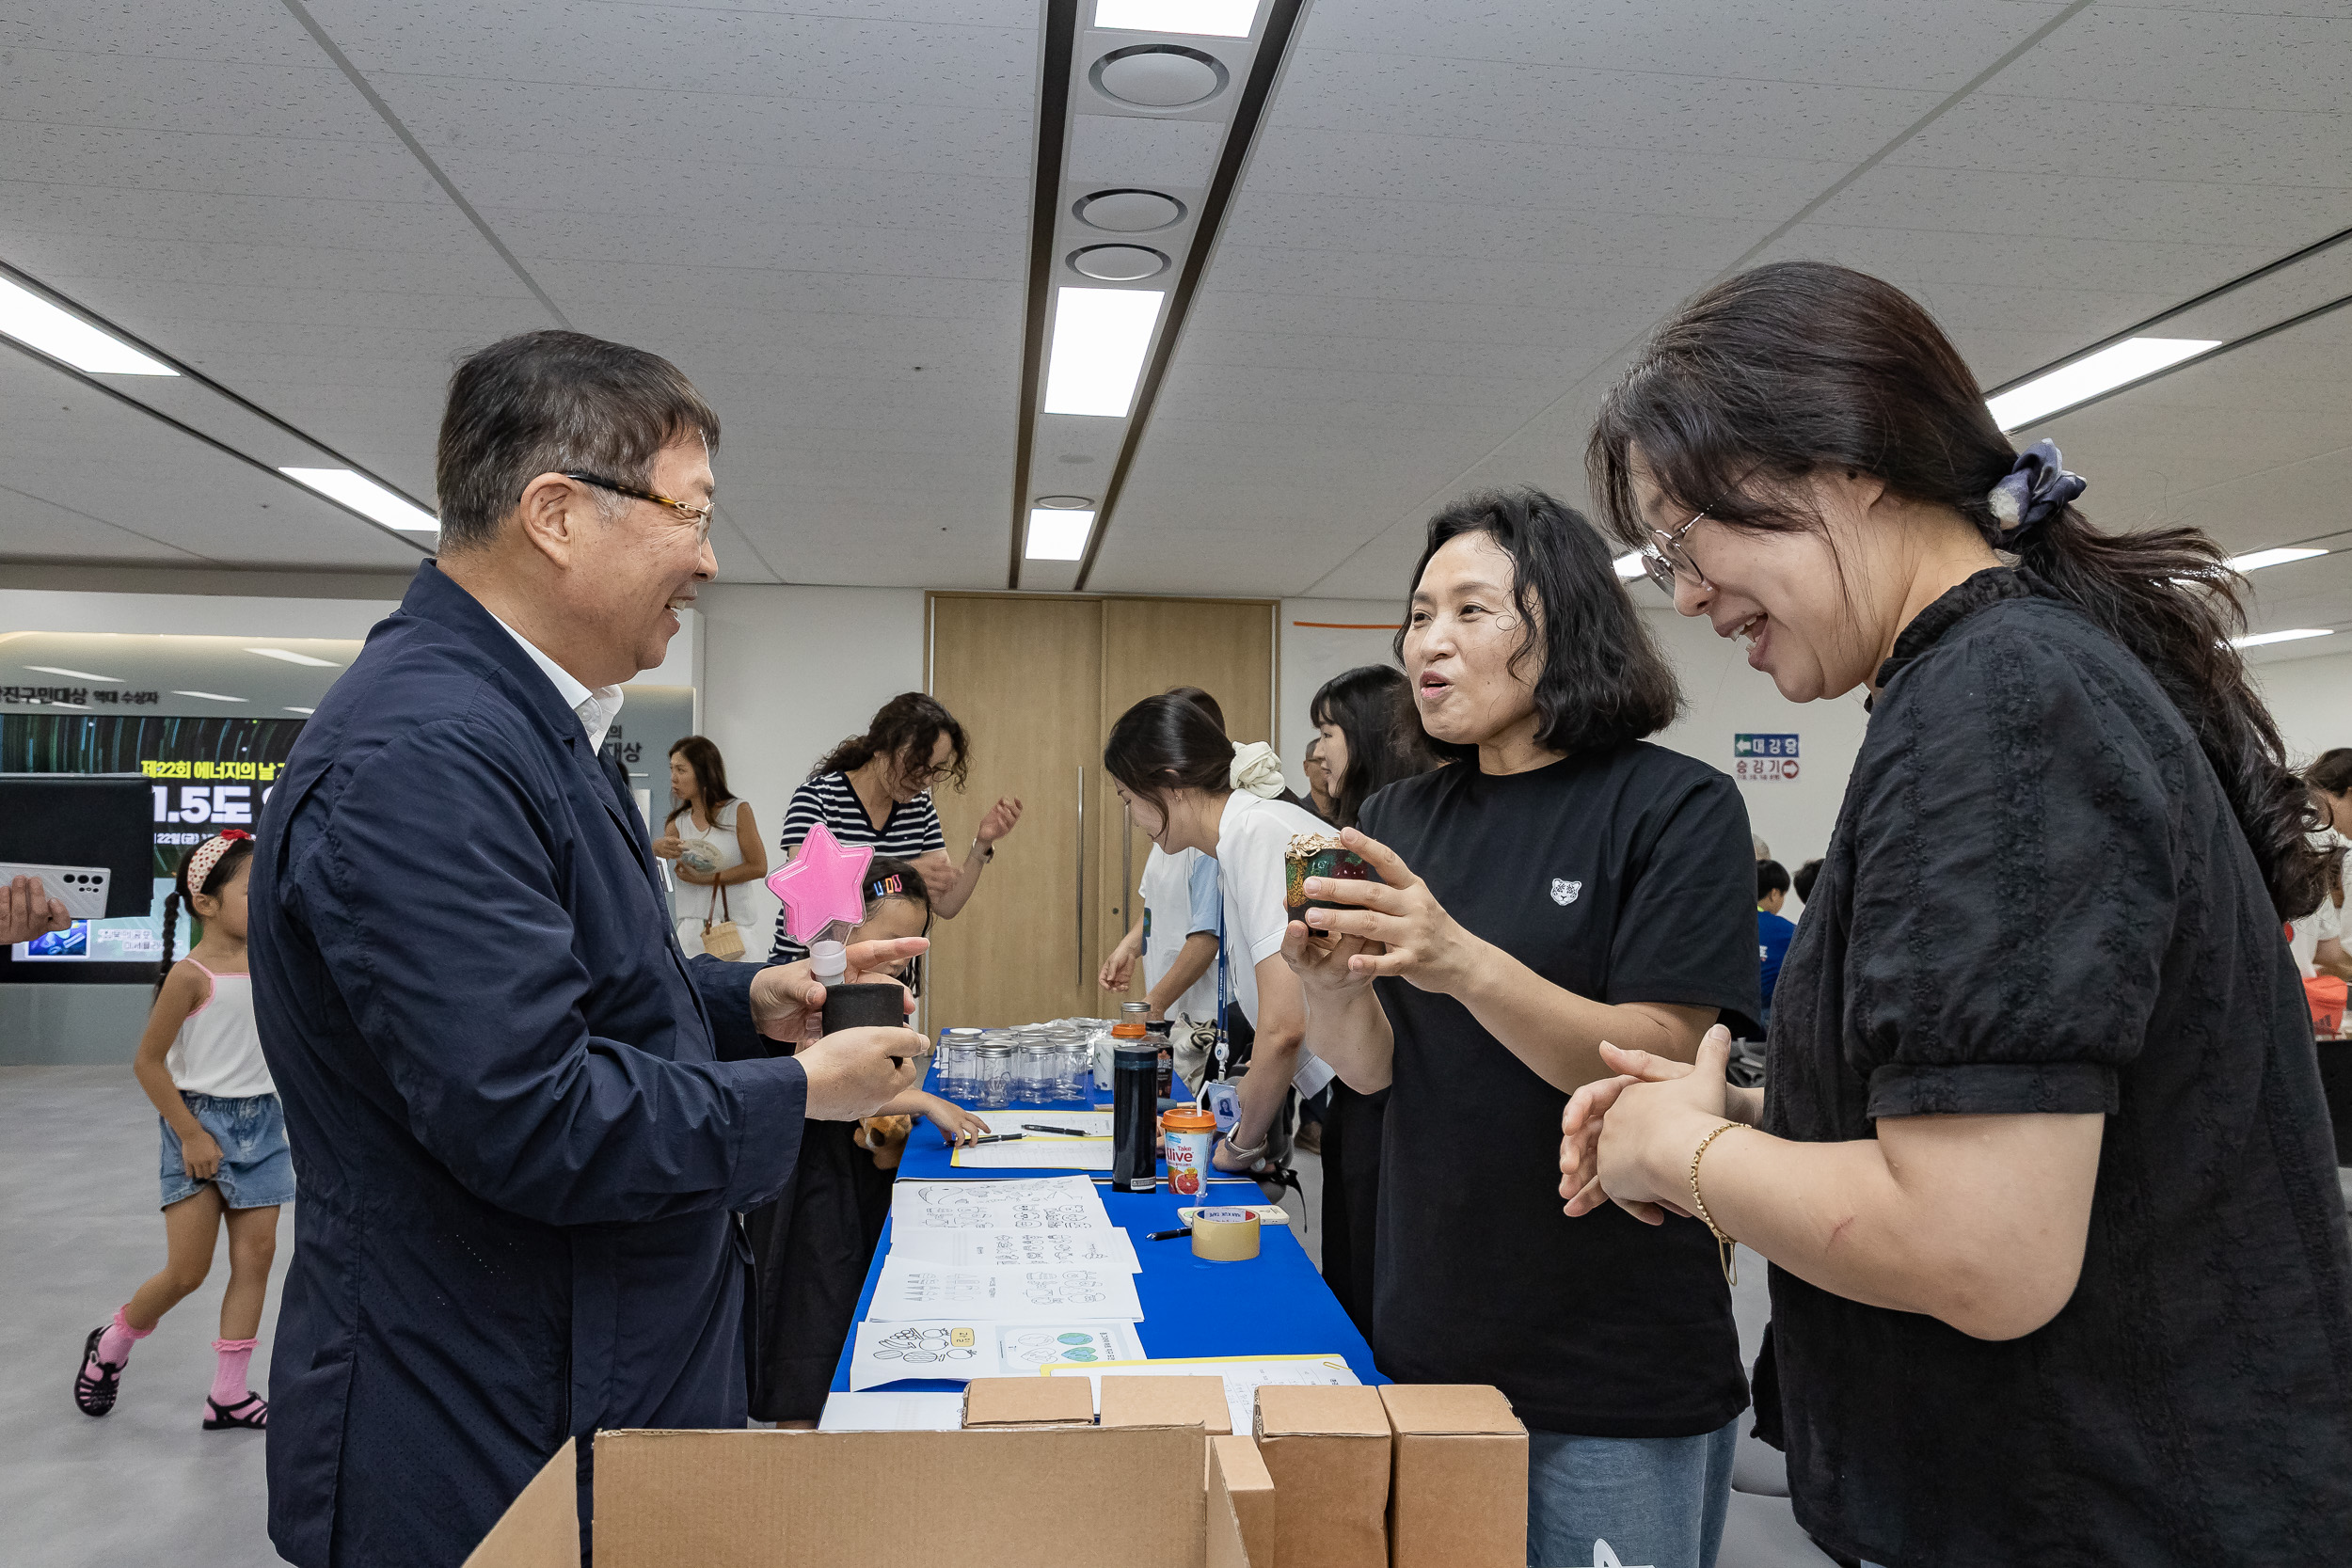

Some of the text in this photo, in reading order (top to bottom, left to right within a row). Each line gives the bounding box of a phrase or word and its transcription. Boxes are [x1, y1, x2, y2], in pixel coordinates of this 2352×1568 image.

[0, 686, 87, 705] 진구민대상
[193, 761, 257, 780] 에너지의
[258, 762, 277, 781] 날
[153, 785, 252, 824] 1.5도
